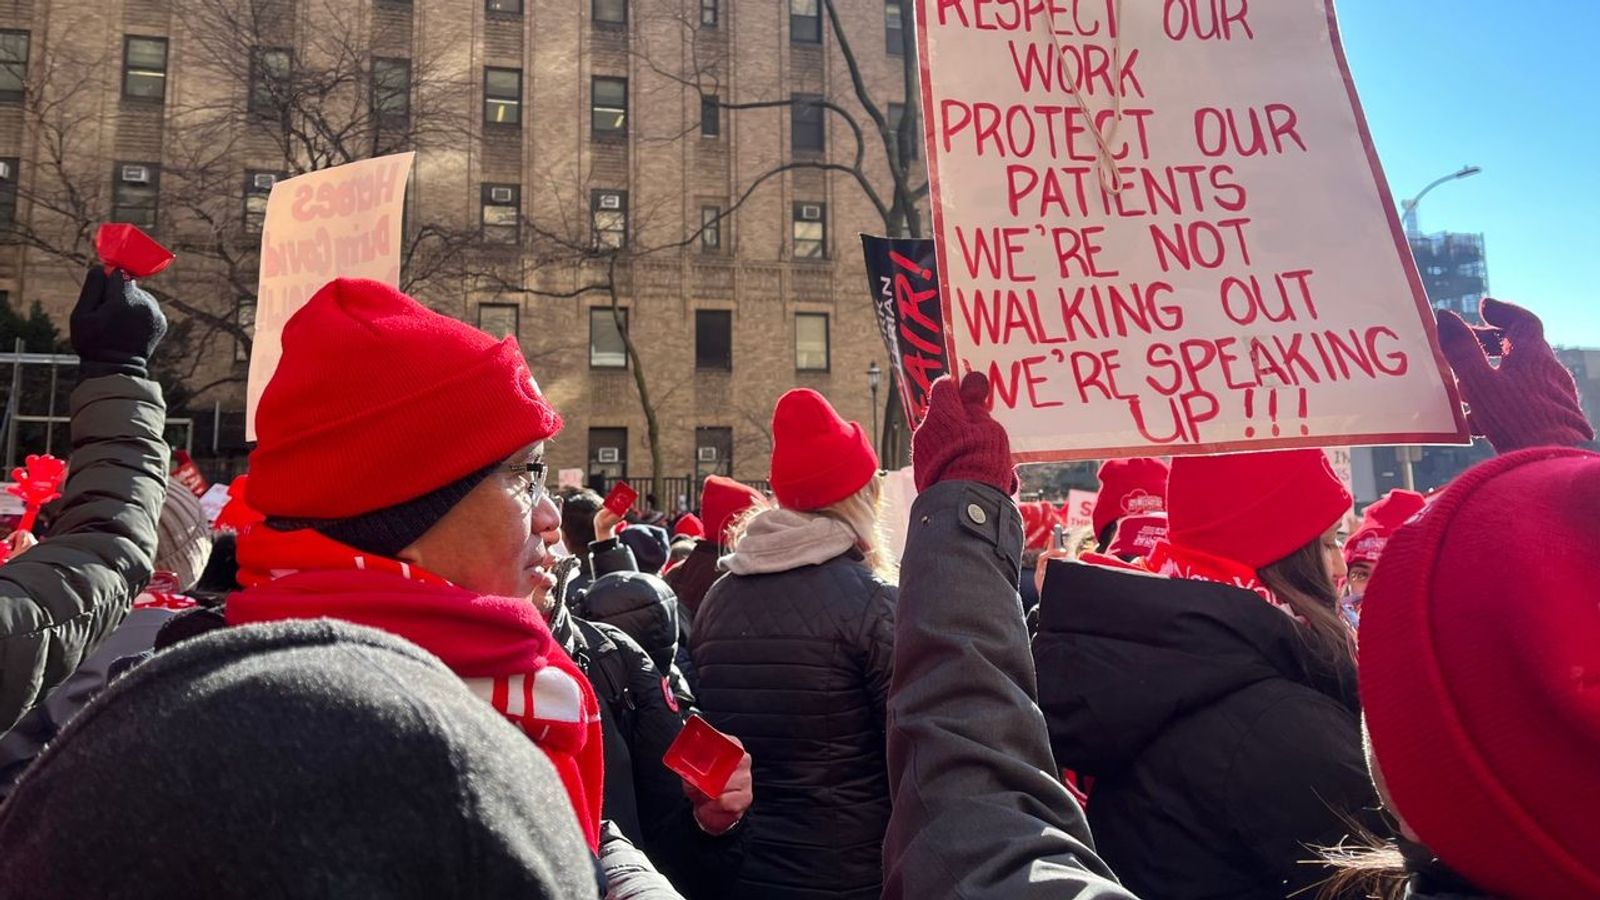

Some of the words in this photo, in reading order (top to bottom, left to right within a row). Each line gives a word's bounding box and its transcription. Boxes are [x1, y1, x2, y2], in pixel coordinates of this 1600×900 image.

[1163, 0, 1254, 41] OUR
[1008, 40, 1145, 98] WORK
[941, 99, 1154, 161] PROTECT
[1194, 103, 1307, 157] OUR
[1006, 164, 1247, 218] PATIENTS
[955, 223, 1119, 283] WE'RE
[1149, 217, 1251, 273] NOT
[956, 281, 1185, 347] WALKING
[1220, 269, 1318, 326] OUT
[961, 348, 1140, 411] WE'RE
[1145, 326, 1409, 397] SPEAKING
